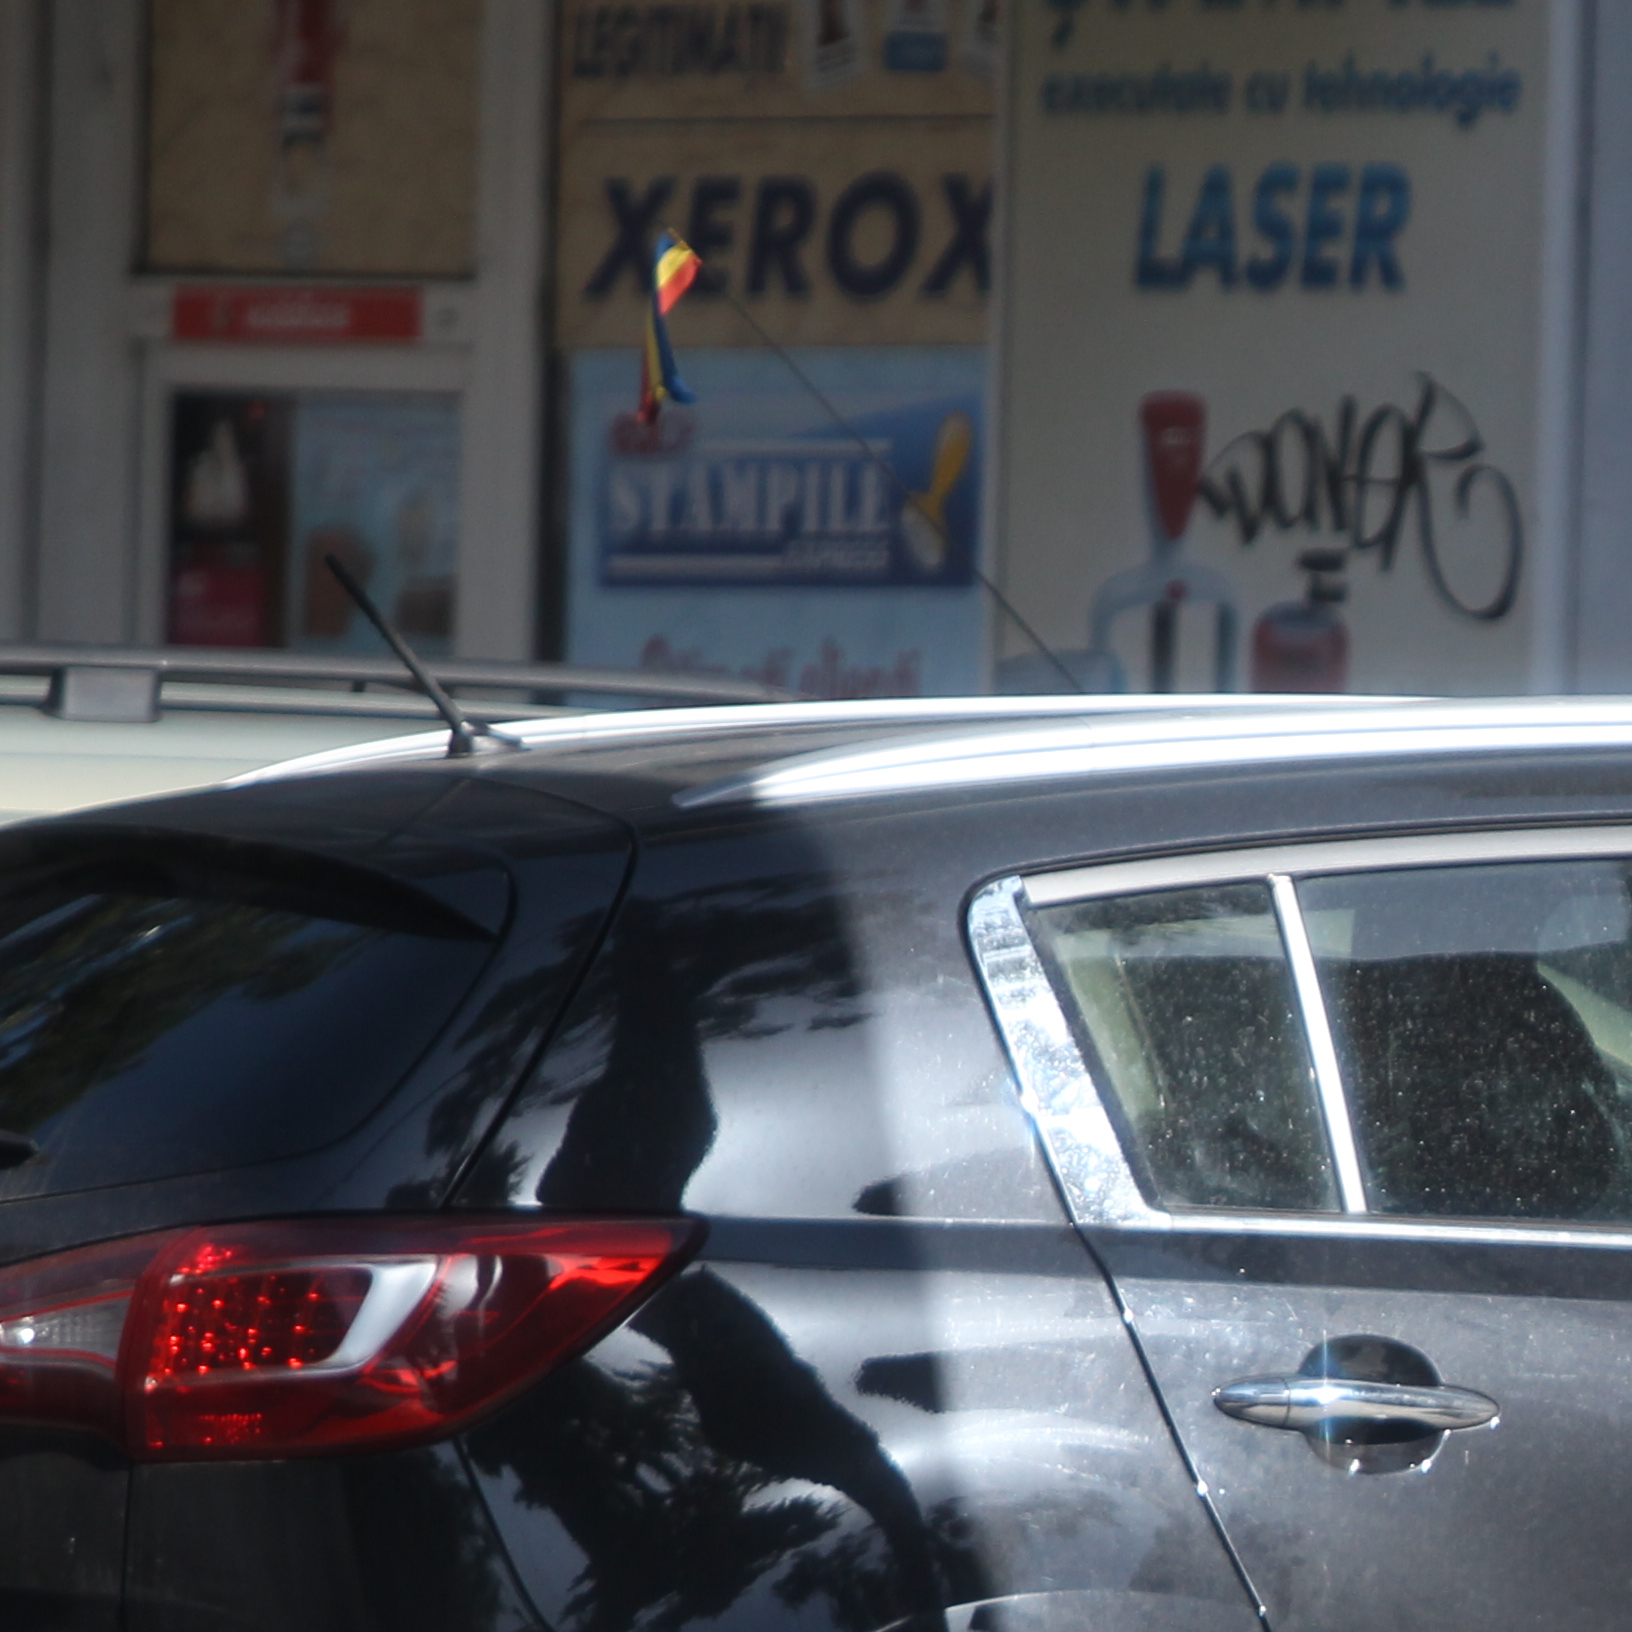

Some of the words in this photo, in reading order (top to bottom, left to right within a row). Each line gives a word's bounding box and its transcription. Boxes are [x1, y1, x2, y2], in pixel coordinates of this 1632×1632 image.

[1040, 60, 1233, 116] executate
[1245, 71, 1293, 117] cu
[1301, 49, 1524, 130] tehnologie
[583, 167, 992, 305] XEROX
[1134, 160, 1413, 292] LASER
